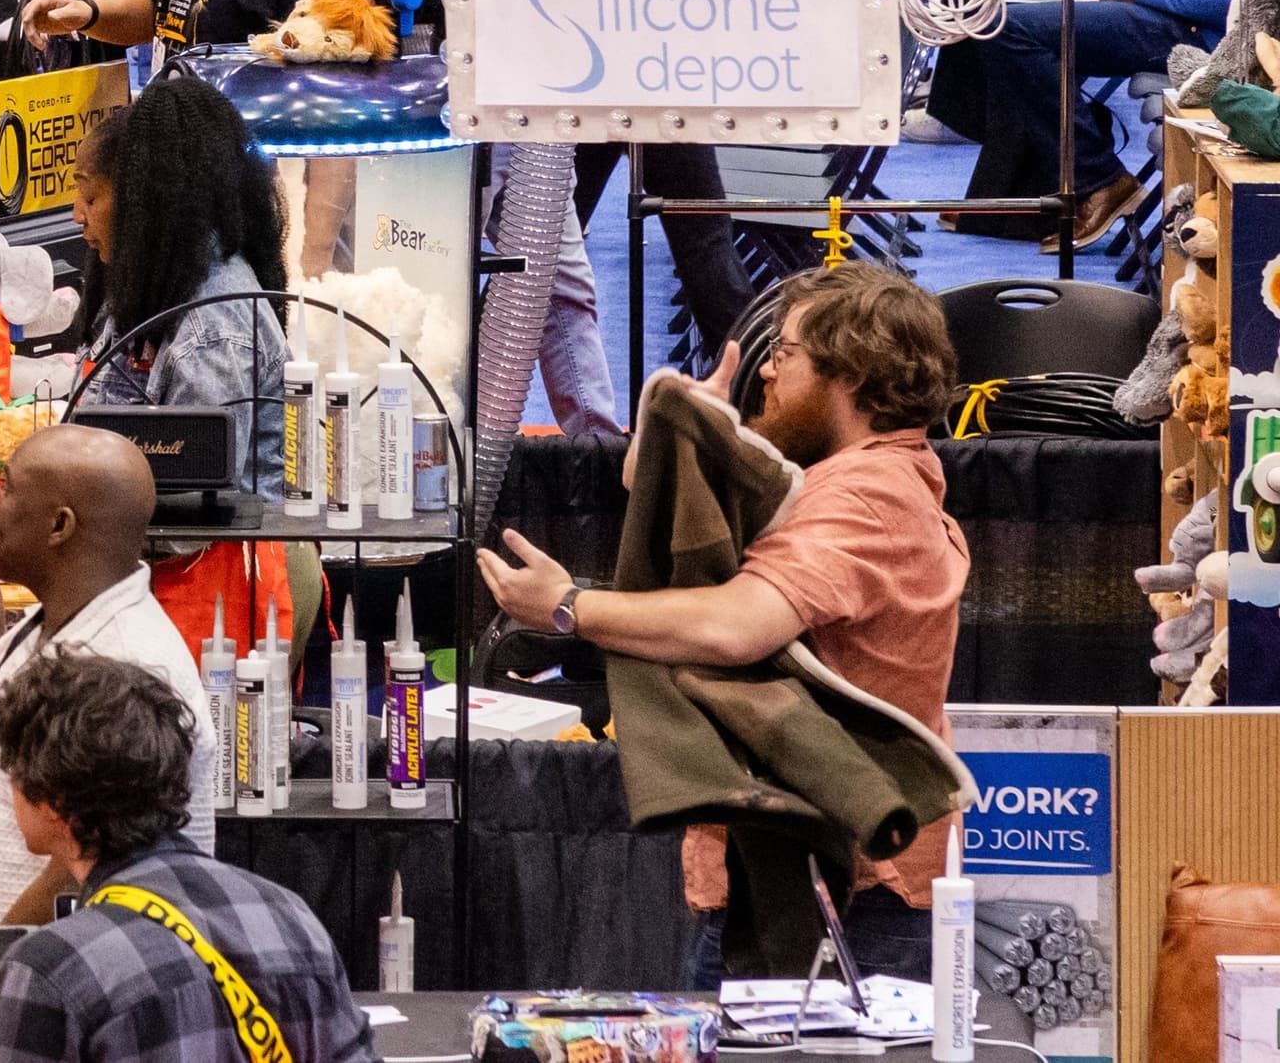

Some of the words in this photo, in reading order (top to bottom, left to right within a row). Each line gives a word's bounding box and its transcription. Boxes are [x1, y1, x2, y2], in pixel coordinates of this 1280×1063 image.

[635, 41, 804, 105] depot
[36, 95, 72, 109] CORD-TIE
[29, 114, 75, 145] KEEP
[78, 104, 128, 135] YO
[29, 138, 83, 173] CORD
[29, 169, 68, 199] TIDY
[390, 218, 426, 251] Bear
[283, 402, 298, 486] SILICONE
[326, 416, 334, 498] SILICONE
[388, 439, 398, 471] SEALANT
[388, 473, 398, 494] JOINT
[405, 687, 419, 725] LATEX
[222, 728, 233, 769] SEALANT
[237, 701, 250, 784] SILICONE
[344, 729, 354, 761] SEALANT
[406, 729, 420, 780] ACRYLIC
[222, 772, 232, 798] JOINT
[990, 829, 1091, 851] JOINTS.
[952, 928, 965, 988] EXPANSION
[952, 990, 965, 1050] CONCRETE
